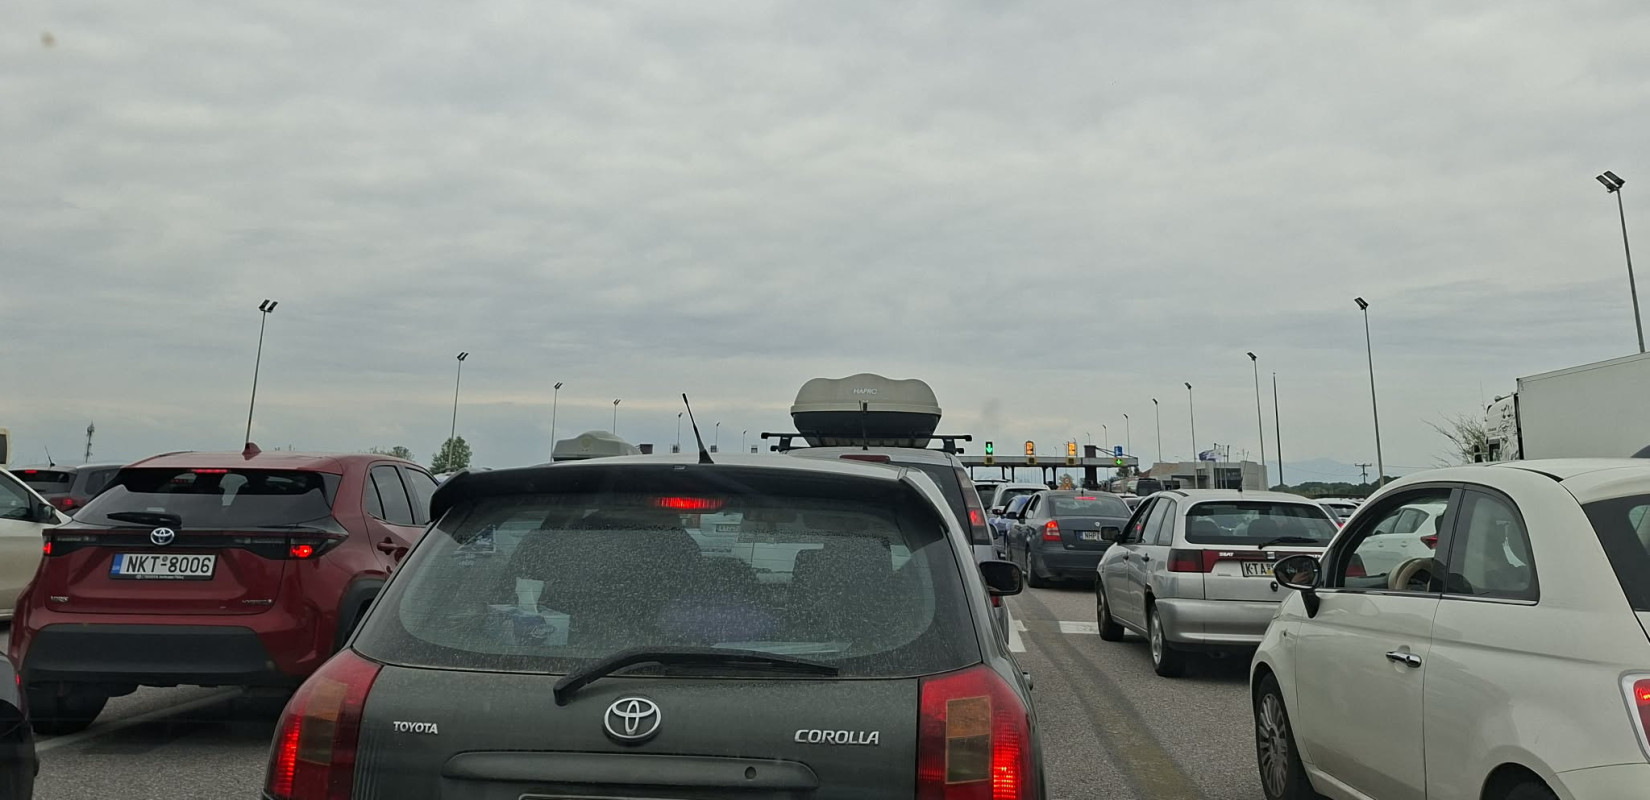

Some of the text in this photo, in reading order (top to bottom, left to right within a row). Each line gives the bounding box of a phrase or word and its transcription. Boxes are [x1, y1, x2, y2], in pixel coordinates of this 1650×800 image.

[853, 387, 878, 395] HAPRO
[393, 721, 438, 734] TOYOTA
[794, 729, 879, 745] COROLLA
